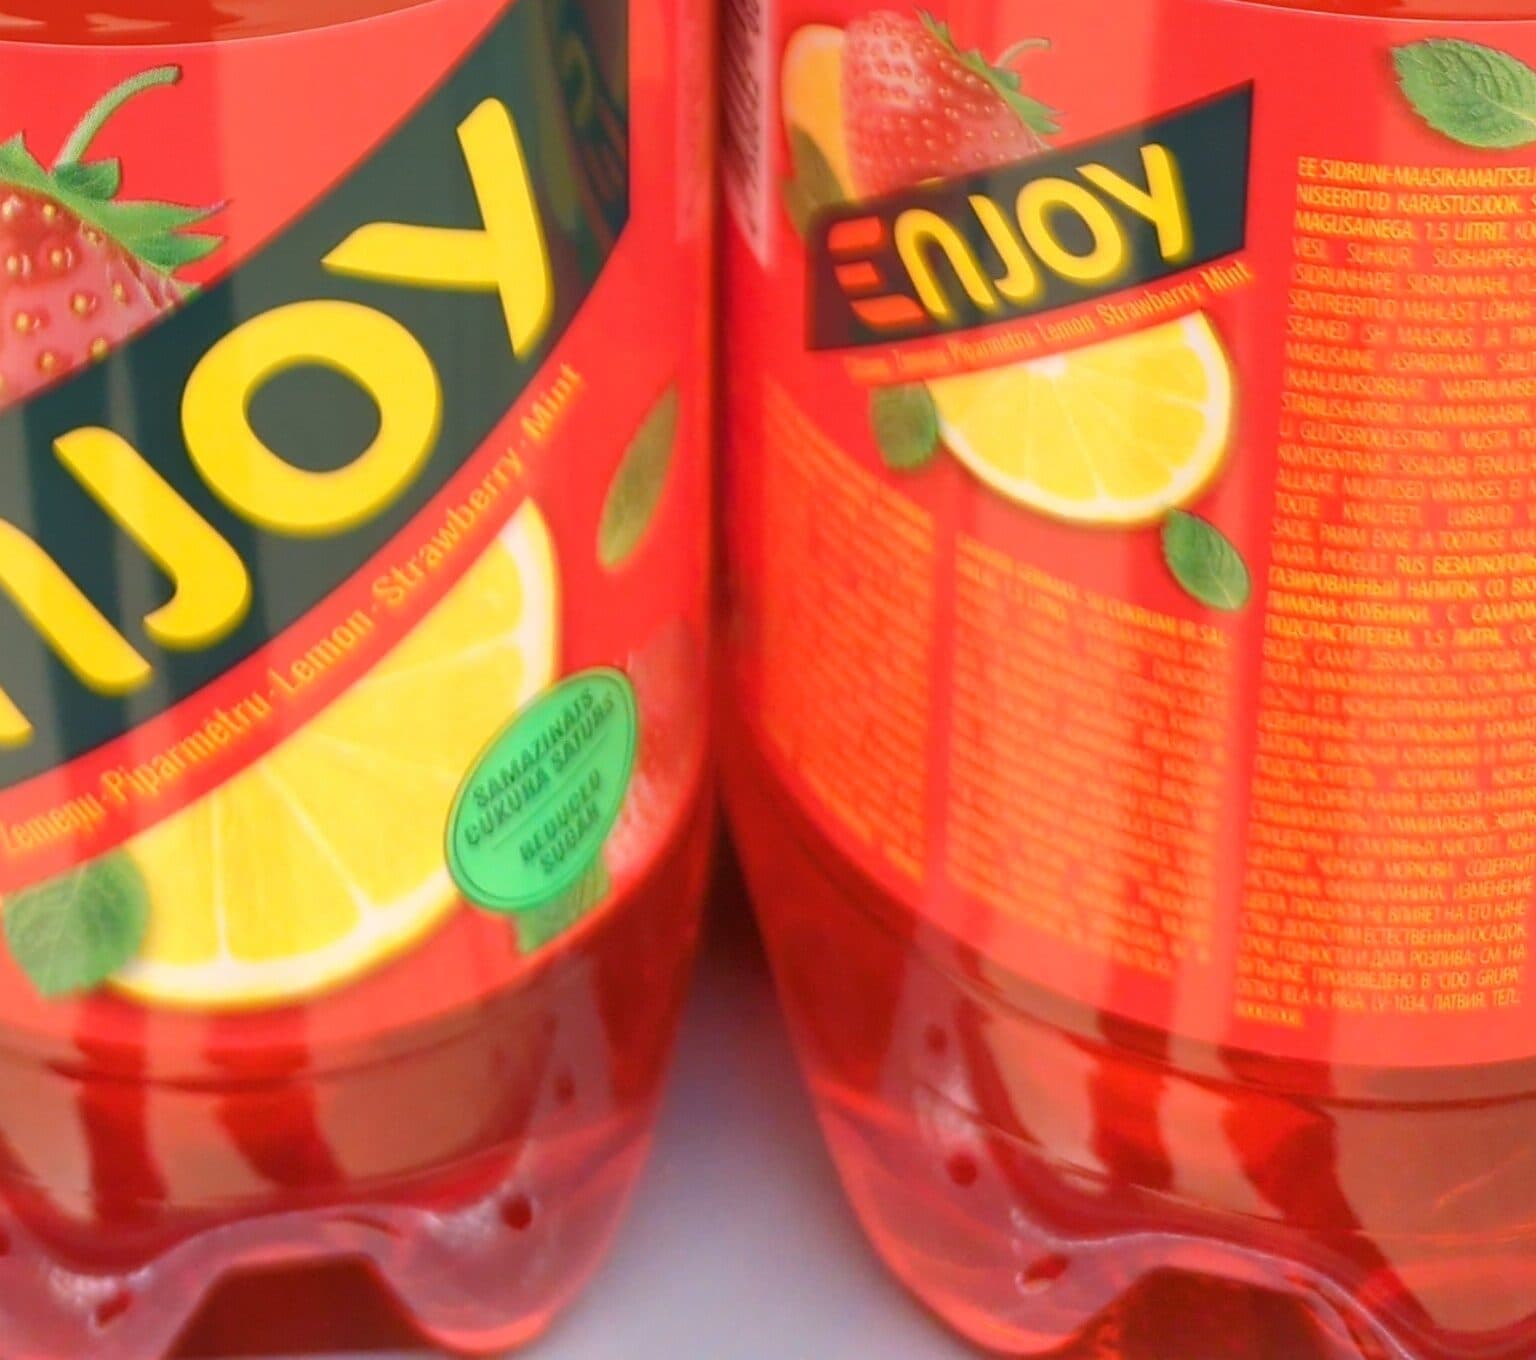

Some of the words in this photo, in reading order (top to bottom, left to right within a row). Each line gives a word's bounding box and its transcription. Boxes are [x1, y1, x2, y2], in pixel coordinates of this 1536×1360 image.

[1296, 183, 1390, 212] NISEERITUD
[1297, 155, 1316, 177] EE
[826, 142, 1188, 328] ENJOY
[1097, 280, 1201, 328] Strawberry
[1202, 258, 1253, 296] Mint
[267, 607, 375, 702] Lemon
[370, 446, 526, 610] Strawberry
[519, 360, 584, 445] Mint
[537, 800, 601, 877] SUGAR
